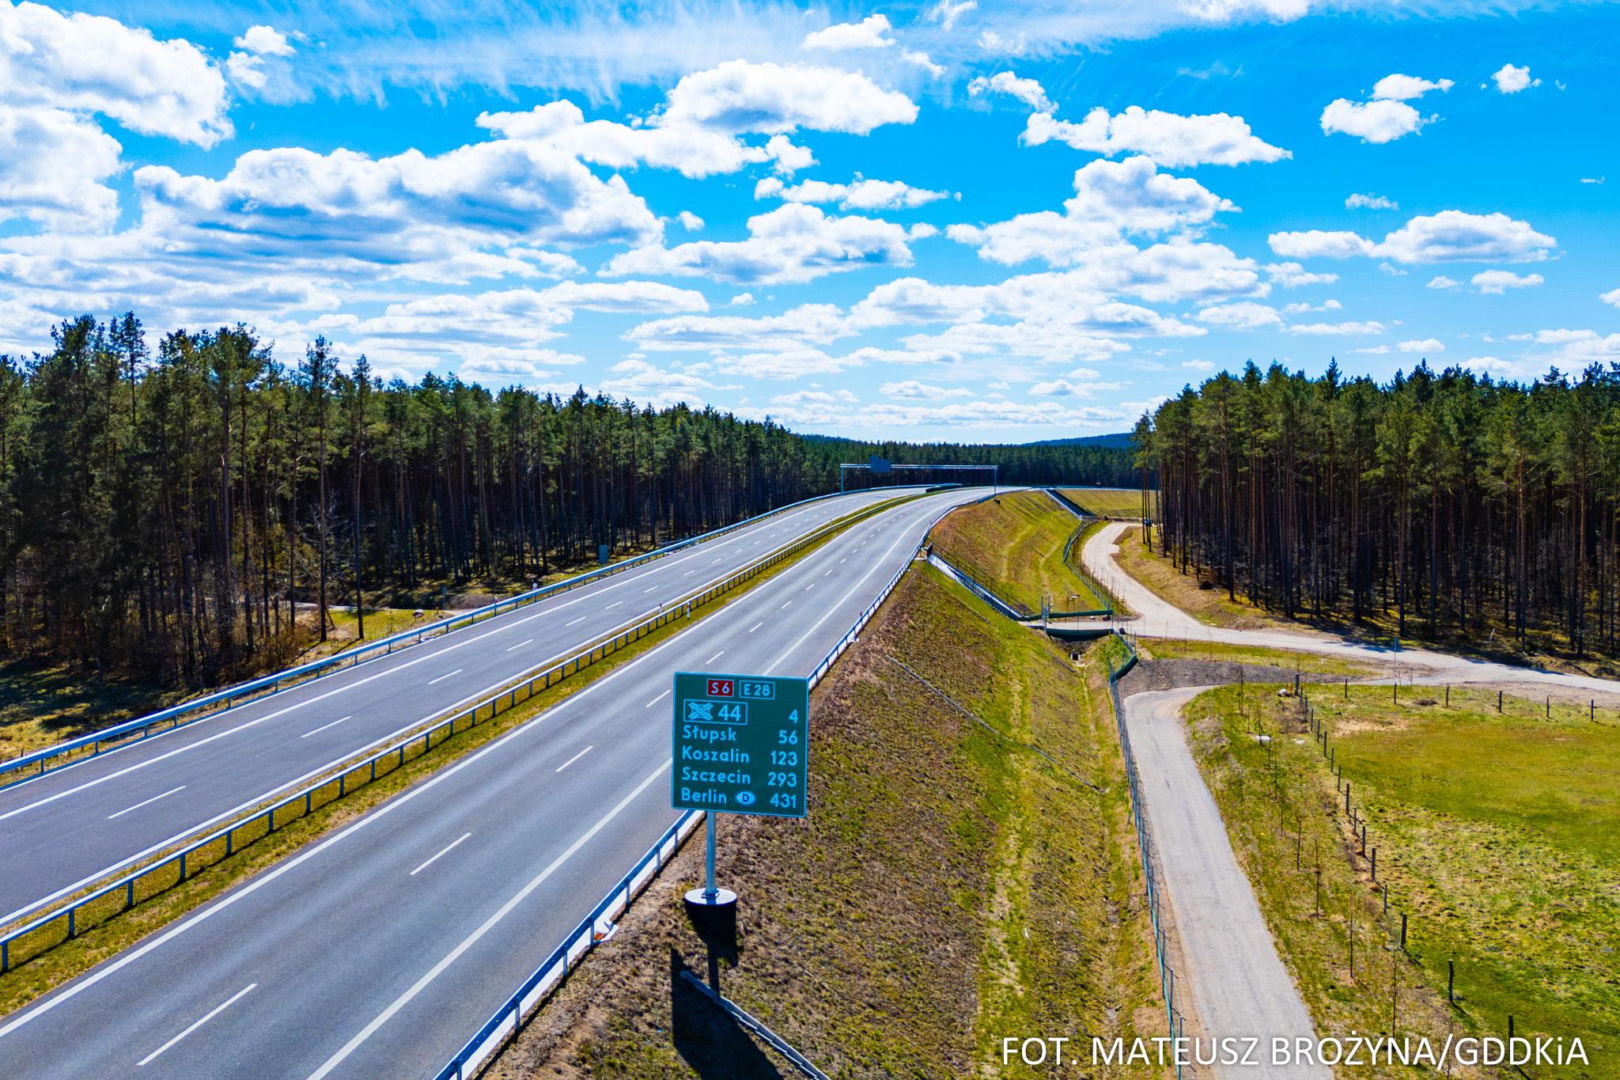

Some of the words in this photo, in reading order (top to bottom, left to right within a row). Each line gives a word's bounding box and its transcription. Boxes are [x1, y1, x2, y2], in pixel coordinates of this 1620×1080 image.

[718, 704, 741, 721] 44
[789, 709, 799, 723] 4
[682, 725, 736, 743] Słupsk
[778, 730, 798, 744] 56
[682, 746, 749, 763] Koszalin
[771, 751, 797, 766] 123
[682, 767, 751, 784] Szczecin
[768, 772, 797, 787] 293
[681, 787, 727, 803] Berlin
[770, 793, 796, 808] 431
